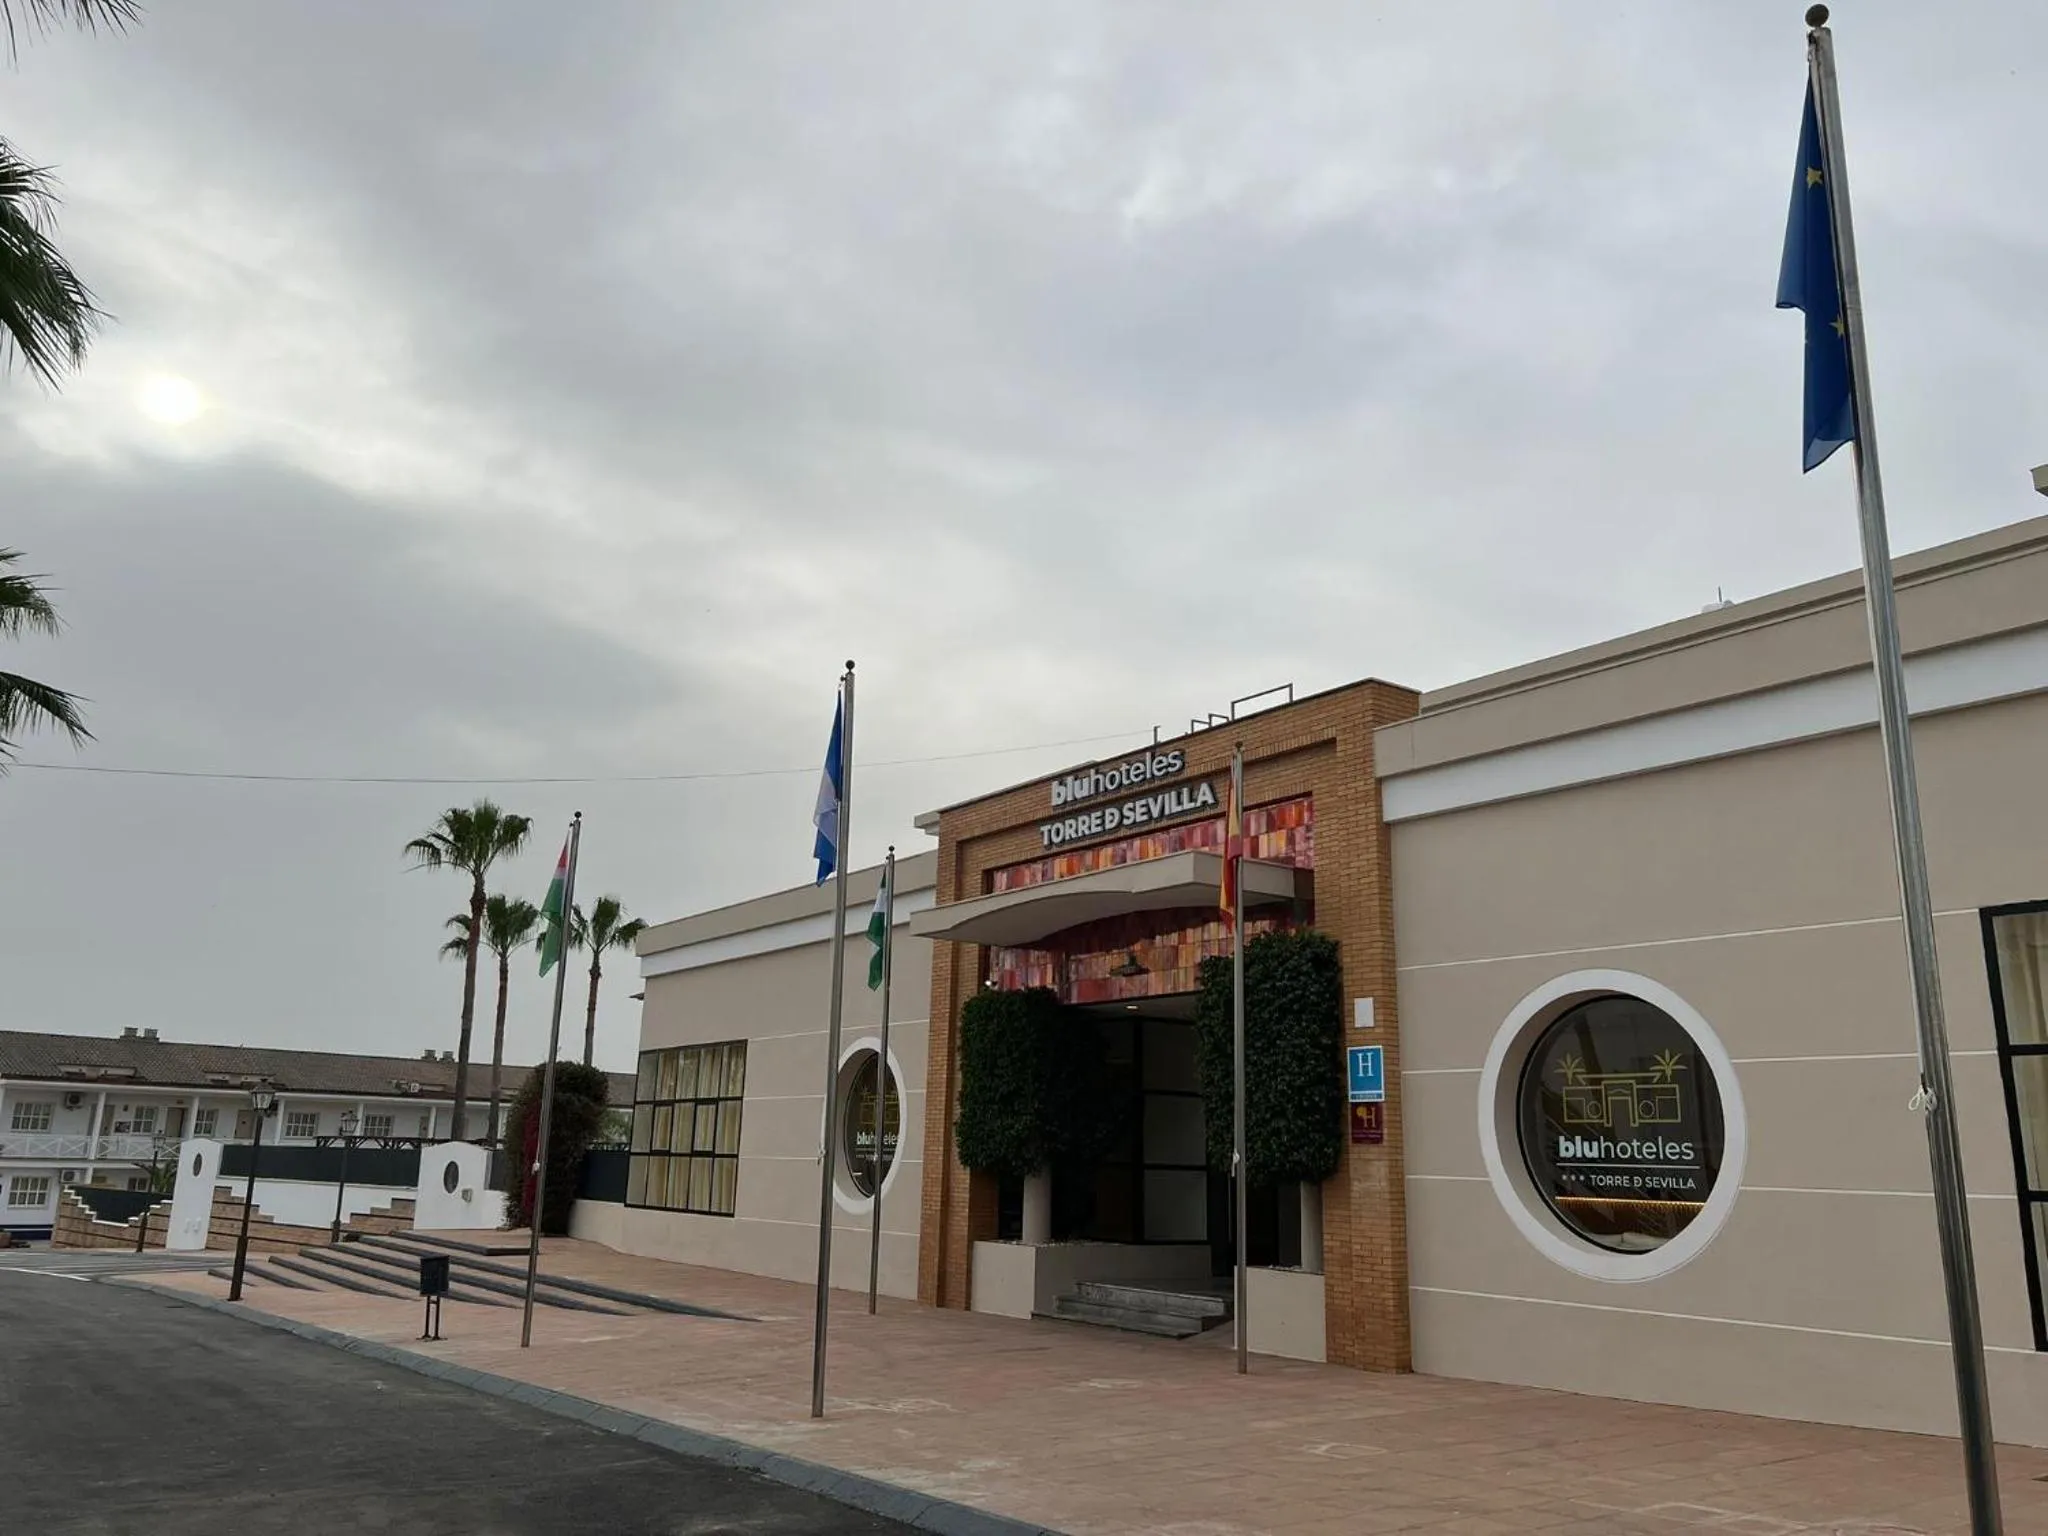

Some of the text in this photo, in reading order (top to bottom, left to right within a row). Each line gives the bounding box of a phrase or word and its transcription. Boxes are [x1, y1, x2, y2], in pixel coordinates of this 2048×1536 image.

[1052, 751, 1184, 806] bluhoteles
[1040, 810, 1103, 846] TORRE
[1122, 783, 1216, 826] SEVILLA
[1357, 1051, 1374, 1077] H
[1559, 1135, 1695, 1160] bluhoteles
[1589, 1174, 1631, 1188] TORRE
[1645, 1176, 1697, 1190] SEVILLA
